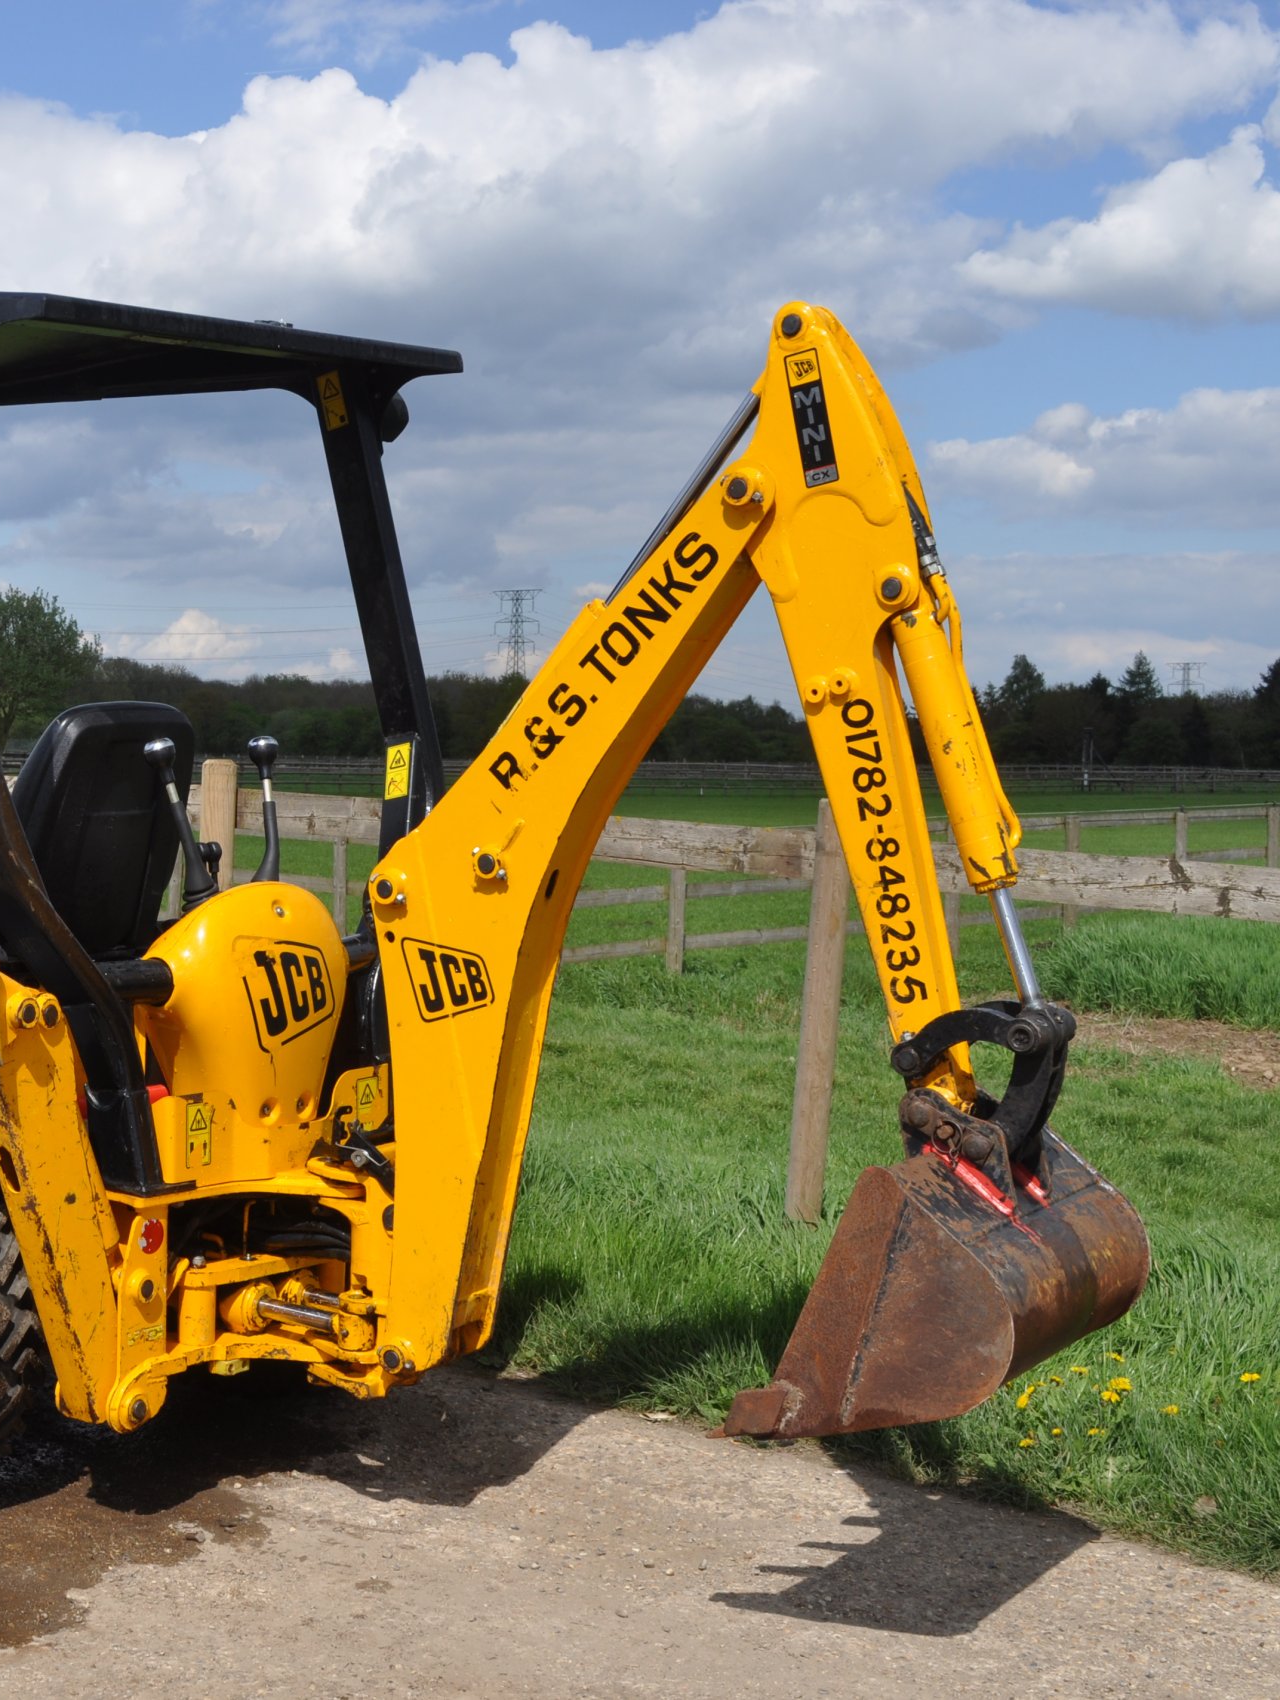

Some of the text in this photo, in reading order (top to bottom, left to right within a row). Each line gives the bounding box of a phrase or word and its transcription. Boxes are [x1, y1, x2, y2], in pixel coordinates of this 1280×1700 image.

[793, 360, 814, 378] JCB
[793, 386, 826, 462] MINI
[811, 470, 830, 481] CX
[841, 698, 928, 1004] 01782-848235
[253, 950, 327, 1037] JCB
[418, 947, 488, 1013] JCB
